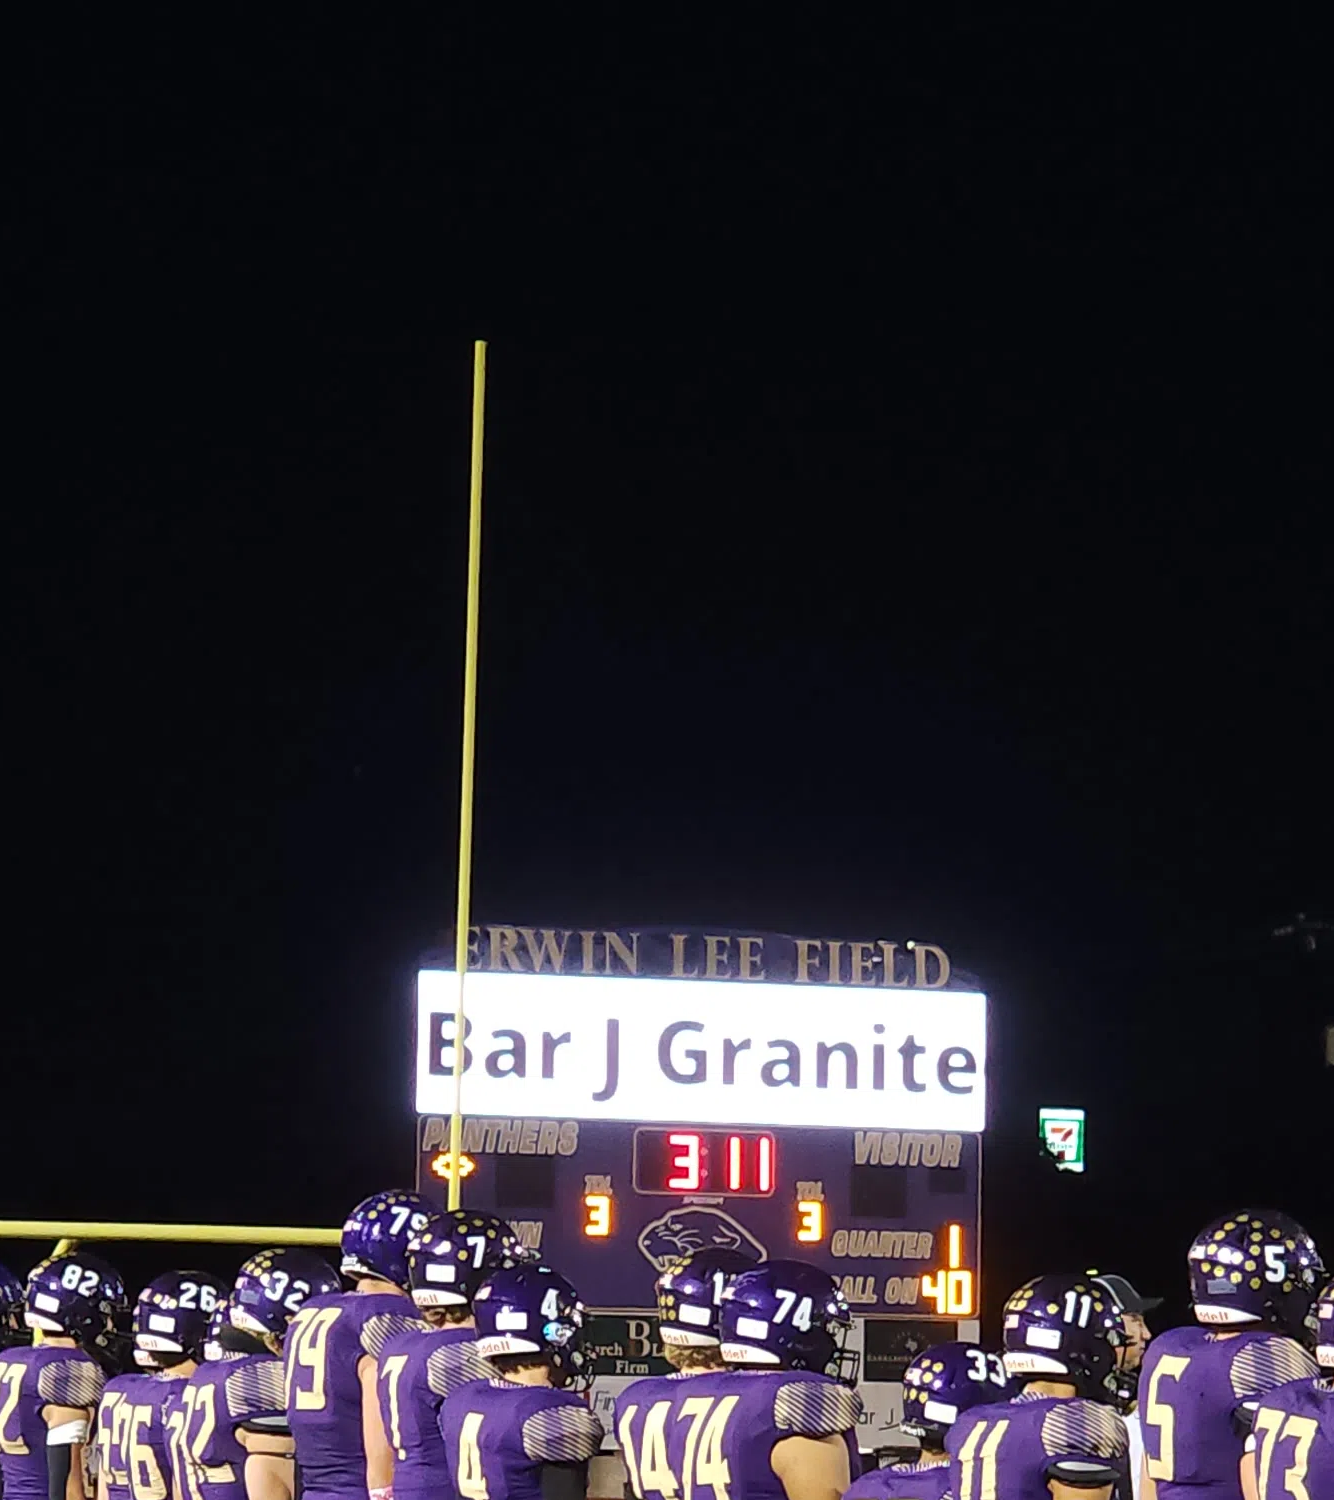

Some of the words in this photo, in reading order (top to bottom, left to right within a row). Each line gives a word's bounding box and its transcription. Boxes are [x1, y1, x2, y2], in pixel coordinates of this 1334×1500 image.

[466, 924, 640, 976] ERWIN
[670, 934, 765, 980] LEE
[794, 939, 951, 989] FIELD
[428, 1012, 571, 1079] Bar
[592, 1018, 619, 1102] J
[658, 1020, 977, 1095] Granite
[422, 1117, 579, 1156] PANTHERS
[854, 1131, 963, 1168] VISITOR
[585, 1195, 610, 1236] 3
[797, 1201, 822, 1242] 3
[466, 1236, 486, 1268] 7
[831, 1230, 933, 1259] QUARTER
[1264, 1244, 1285, 1283] 5
[61, 1264, 100, 1297] 82
[178, 1281, 217, 1313] 26
[264, 1271, 310, 1313] 32
[921, 1269, 973, 1315] 40
[540, 1287, 559, 1320] 4
[772, 1288, 813, 1332] 74
[1063, 1290, 1092, 1329] 11
[966, 1349, 1006, 1388] 33
[856, 1411, 876, 1425] ar
[1145, 1353, 1187, 1482] 5
